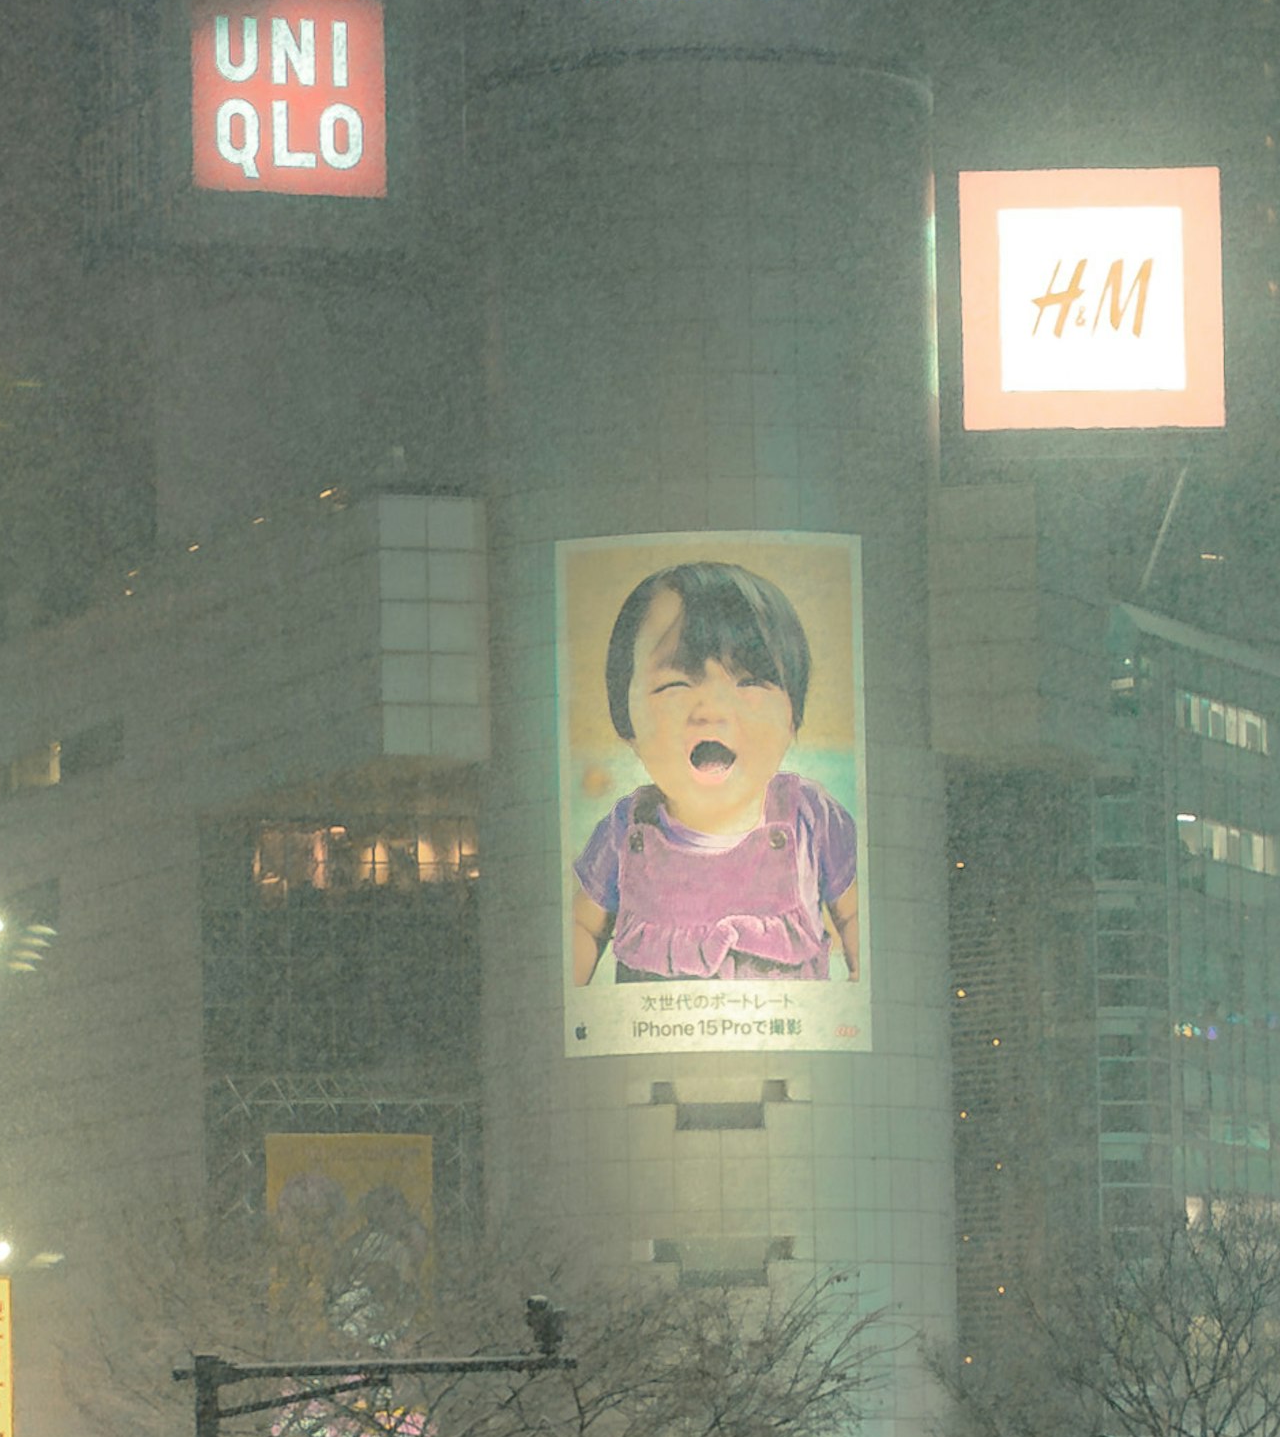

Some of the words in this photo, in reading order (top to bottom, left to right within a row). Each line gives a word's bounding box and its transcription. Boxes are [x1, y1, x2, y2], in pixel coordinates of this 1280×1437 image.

[214, 16, 347, 89] UNI
[217, 97, 363, 178] QLO
[1030, 257, 1154, 339] H&M
[632, 1020, 695, 1037] iPhone
[699, 1020, 718, 1036] 15
[722, 1019, 802, 1036] Proで撮影
[641, 994, 794, 1011] 次世代のポートレート
